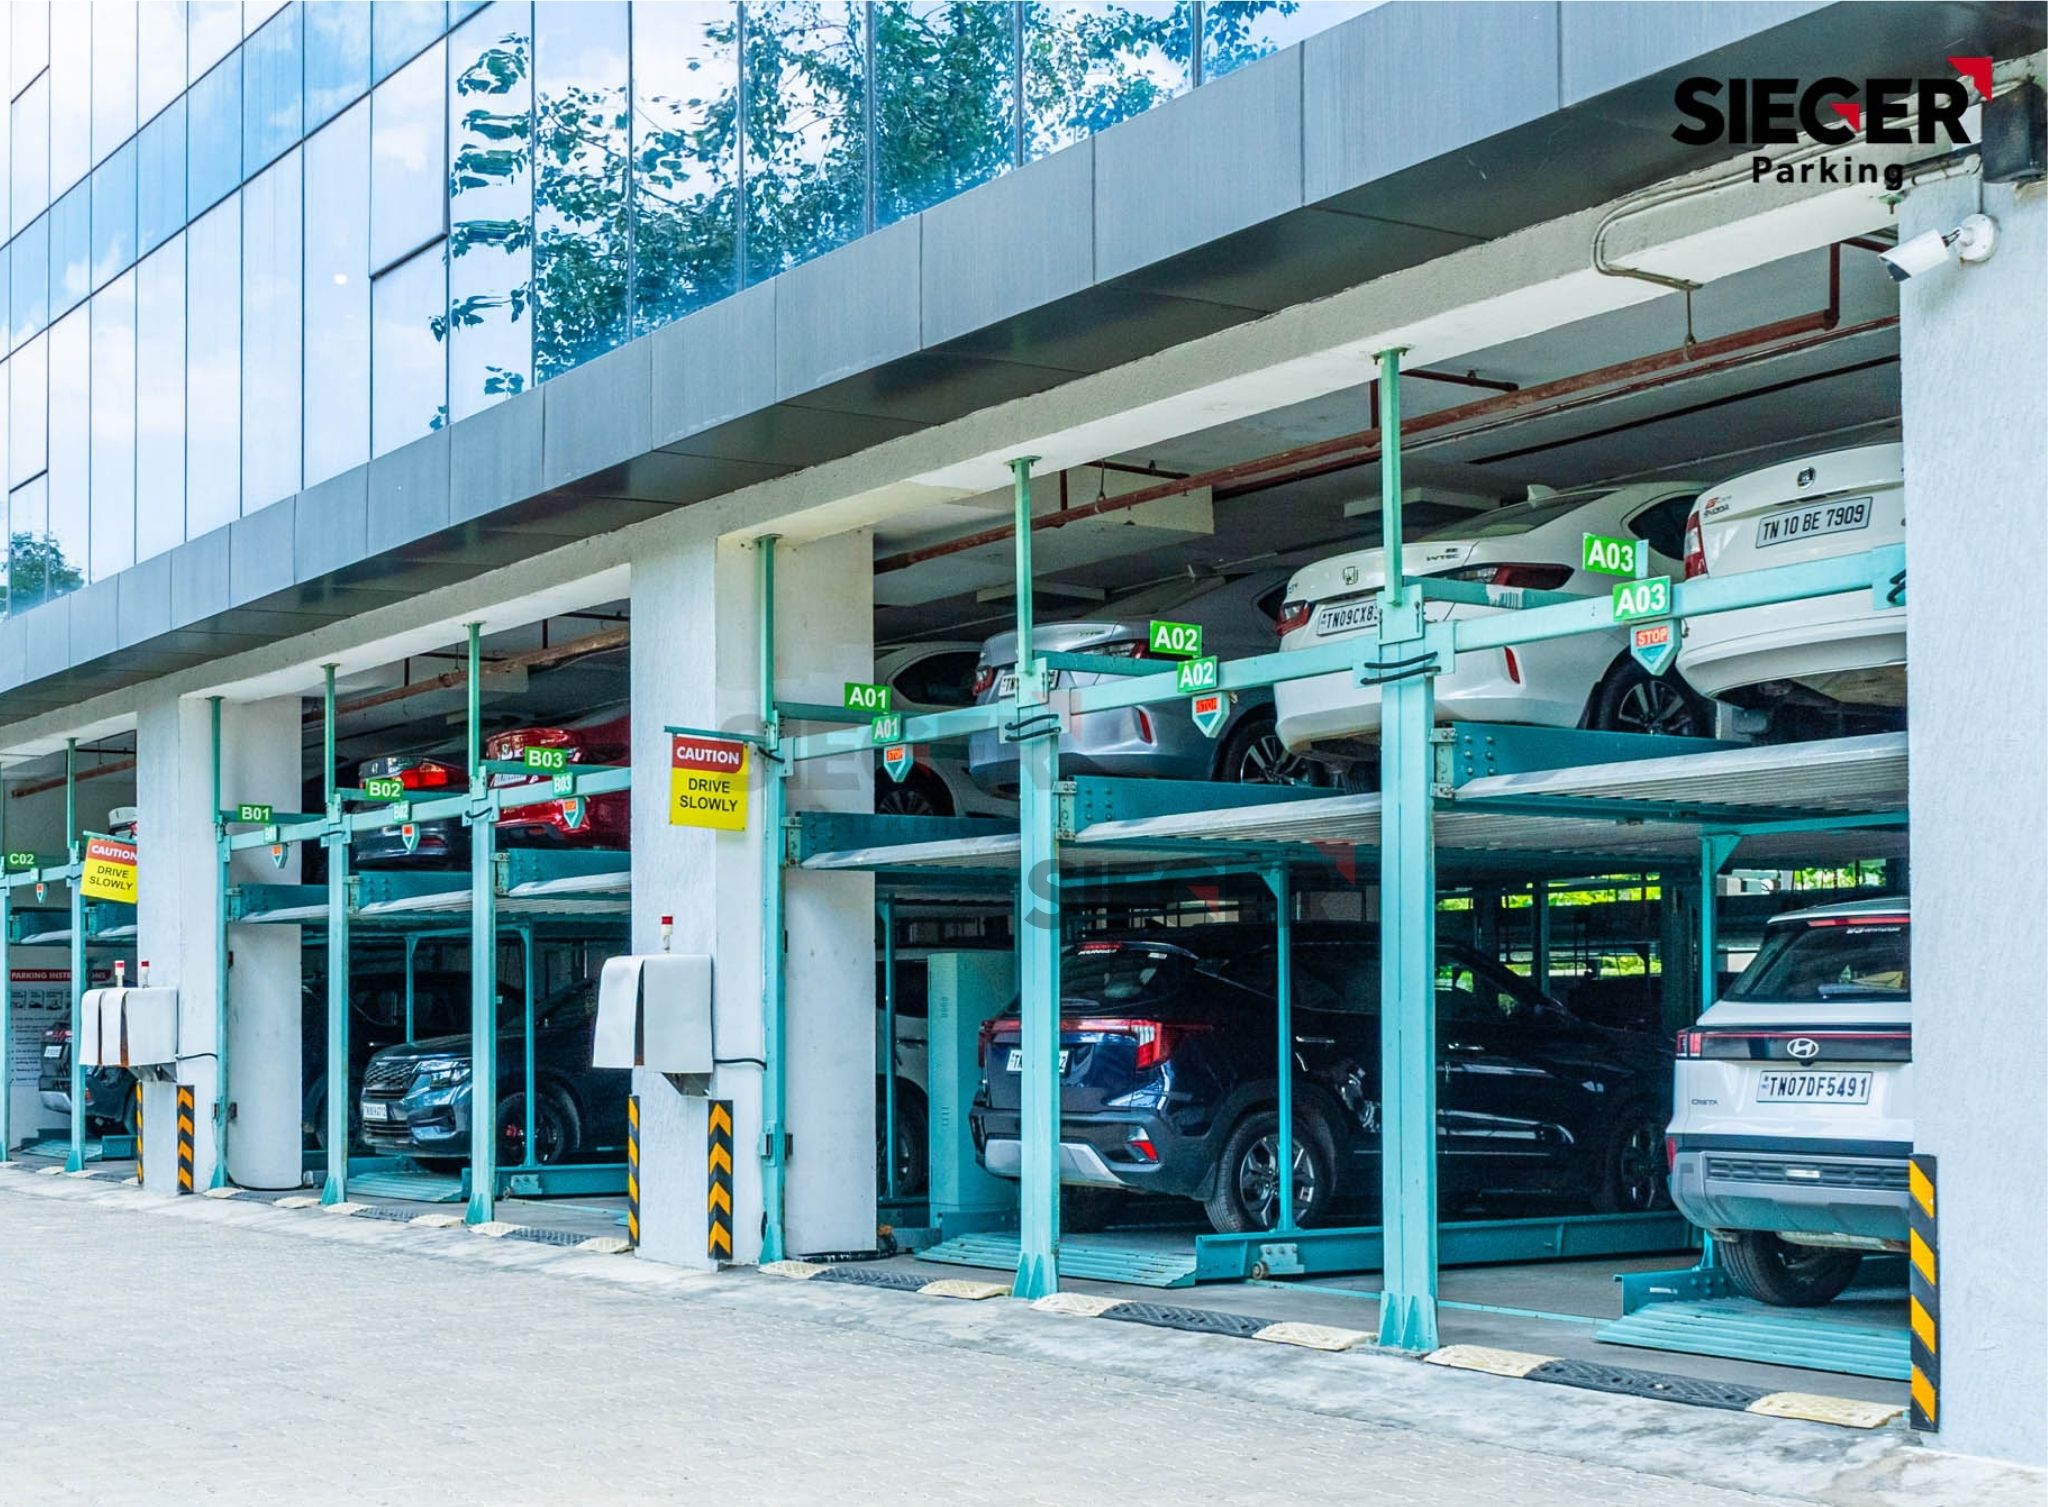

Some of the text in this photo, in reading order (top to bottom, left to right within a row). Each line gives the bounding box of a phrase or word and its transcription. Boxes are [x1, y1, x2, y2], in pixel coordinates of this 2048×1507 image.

[1763, 504, 1865, 541] TN 10 BE 7909
[1588, 540, 1633, 572] A03
[1616, 583, 1666, 616] A03
[1326, 605, 1378, 629] TN09CX8
[1155, 626, 1198, 651] A02
[1637, 627, 1668, 645] STOP
[1179, 661, 1214, 688] A02
[849, 687, 886, 708] A01
[874, 718, 898, 740] A01
[529, 751, 563, 768] B03
[677, 746, 740, 765] CAUTION
[369, 782, 400, 797] B02
[688, 777, 731, 793] DRIVE
[680, 795, 738, 812] SLOWLY
[241, 807, 270, 820] B01
[9, 853, 34, 864] C02
[97, 866, 129, 878] DRIVE
[89, 876, 133, 890] SLOWLY
[1769, 1077, 1868, 1098] TN07DF5491
